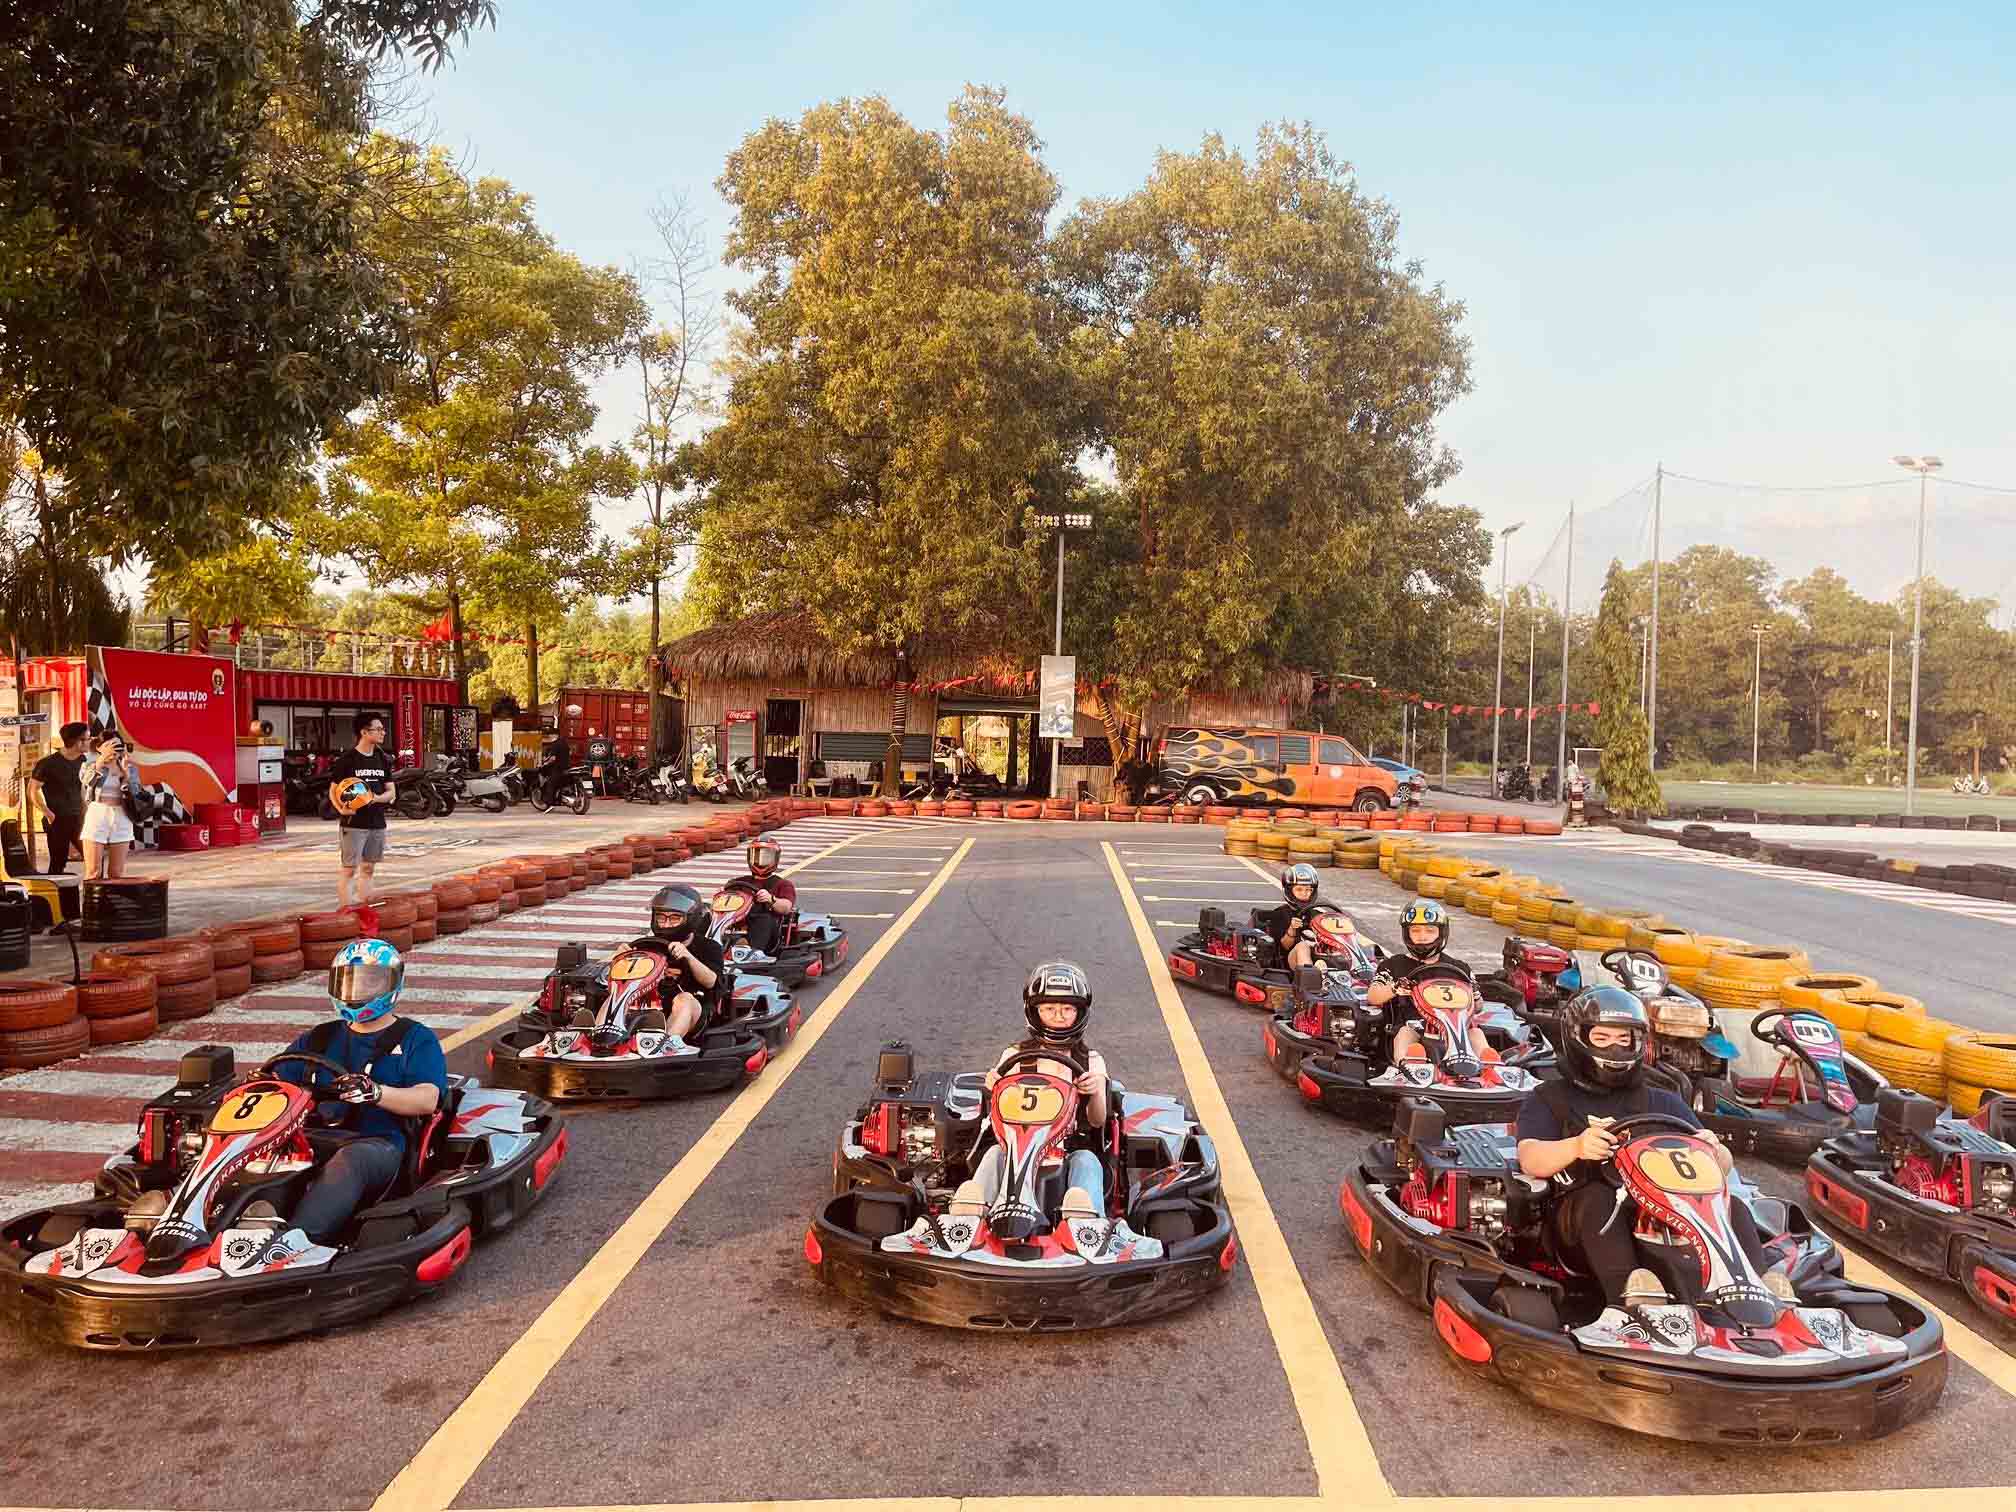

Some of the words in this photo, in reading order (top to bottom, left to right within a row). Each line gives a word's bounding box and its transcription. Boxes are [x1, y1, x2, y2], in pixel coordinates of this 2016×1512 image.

[626, 959, 640, 974] 7
[1440, 986, 1453, 1002] 3
[233, 1094, 262, 1120] 8
[1021, 1087, 1040, 1112] 5
[221, 1154, 250, 1181] KART
[255, 1136, 281, 1157] VIET
[1668, 1151, 1697, 1180] 6
[1631, 1186, 1663, 1214] KART
[1665, 1213, 1691, 1233] VIET
[1691, 1236, 1706, 1265] NAM
